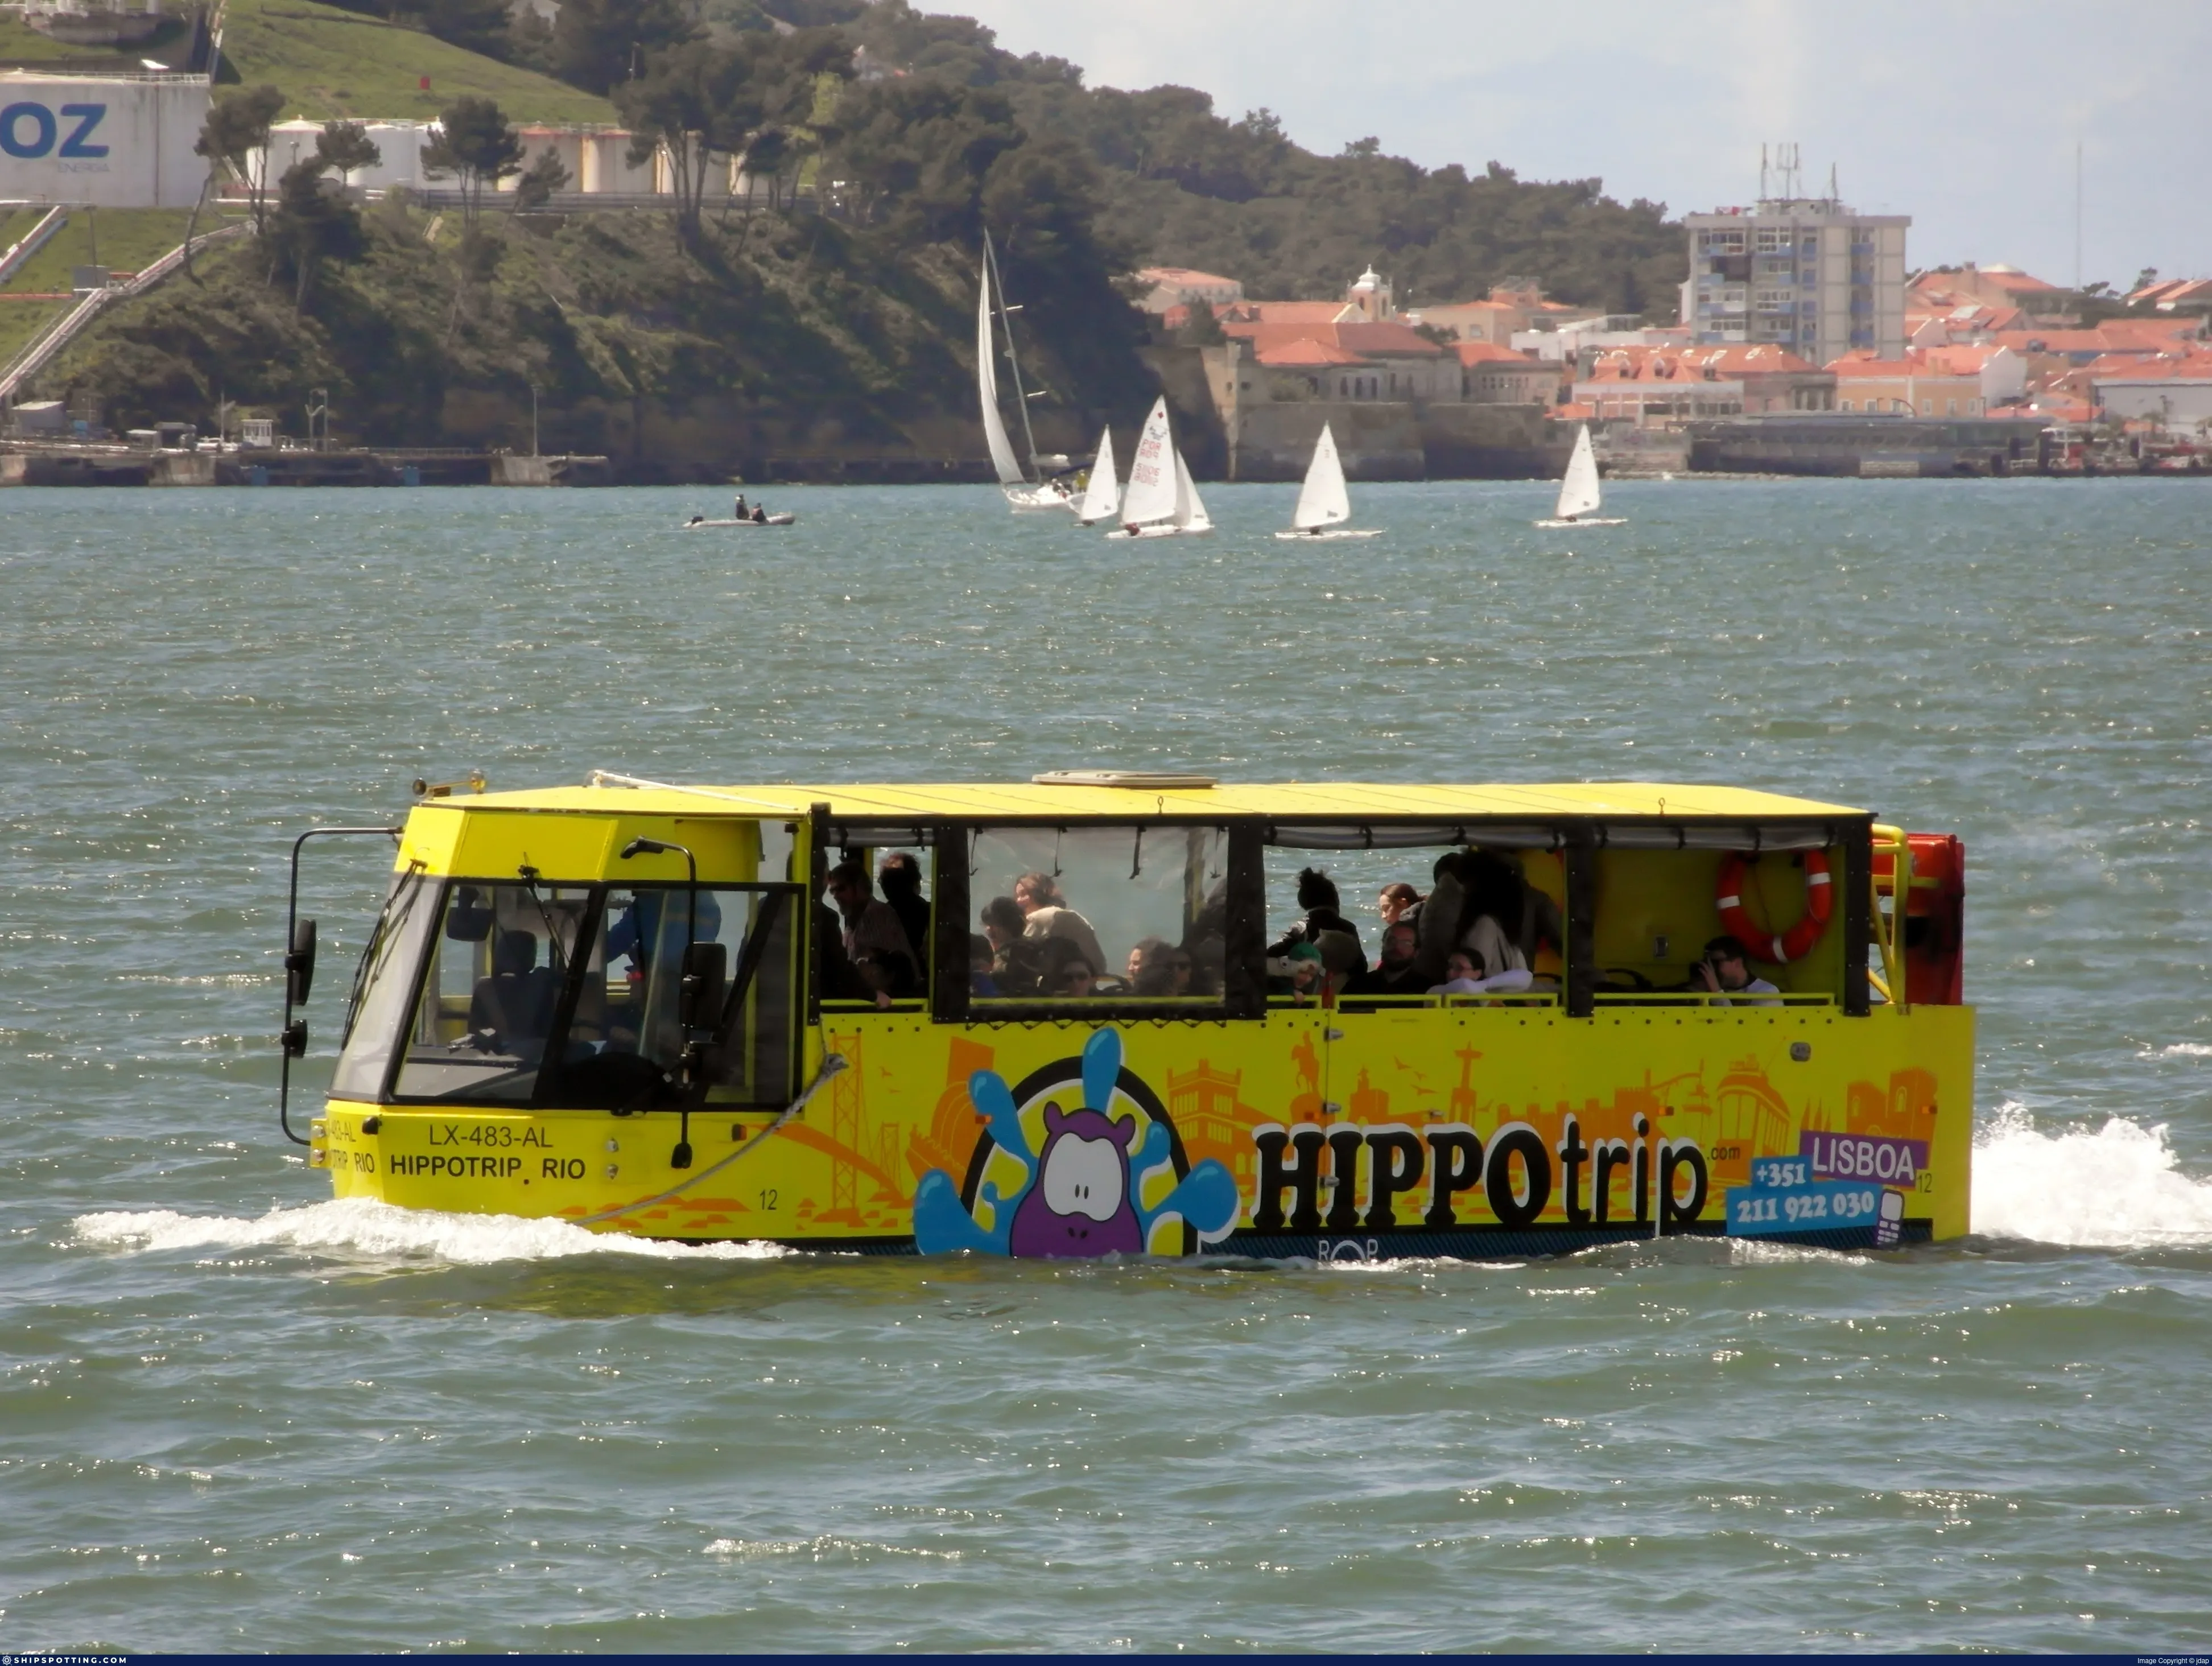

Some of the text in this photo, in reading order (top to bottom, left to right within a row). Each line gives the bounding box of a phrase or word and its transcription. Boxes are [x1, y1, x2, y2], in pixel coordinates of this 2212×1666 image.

[0, 101, 109, 158] OZ
[429, 1124, 554, 1148] LX-483-AL
[354, 1152, 375, 1173] RIO
[391, 1154, 585, 1180] HIPPOTRIP RIO
[1813, 1137, 1915, 1181] LISBOA
[1757, 1163, 1806, 1187] +351
[1917, 1173, 1932, 1193] 12
[760, 1189, 778, 1210] 12
[1737, 1191, 1875, 1223] 211 922 030
